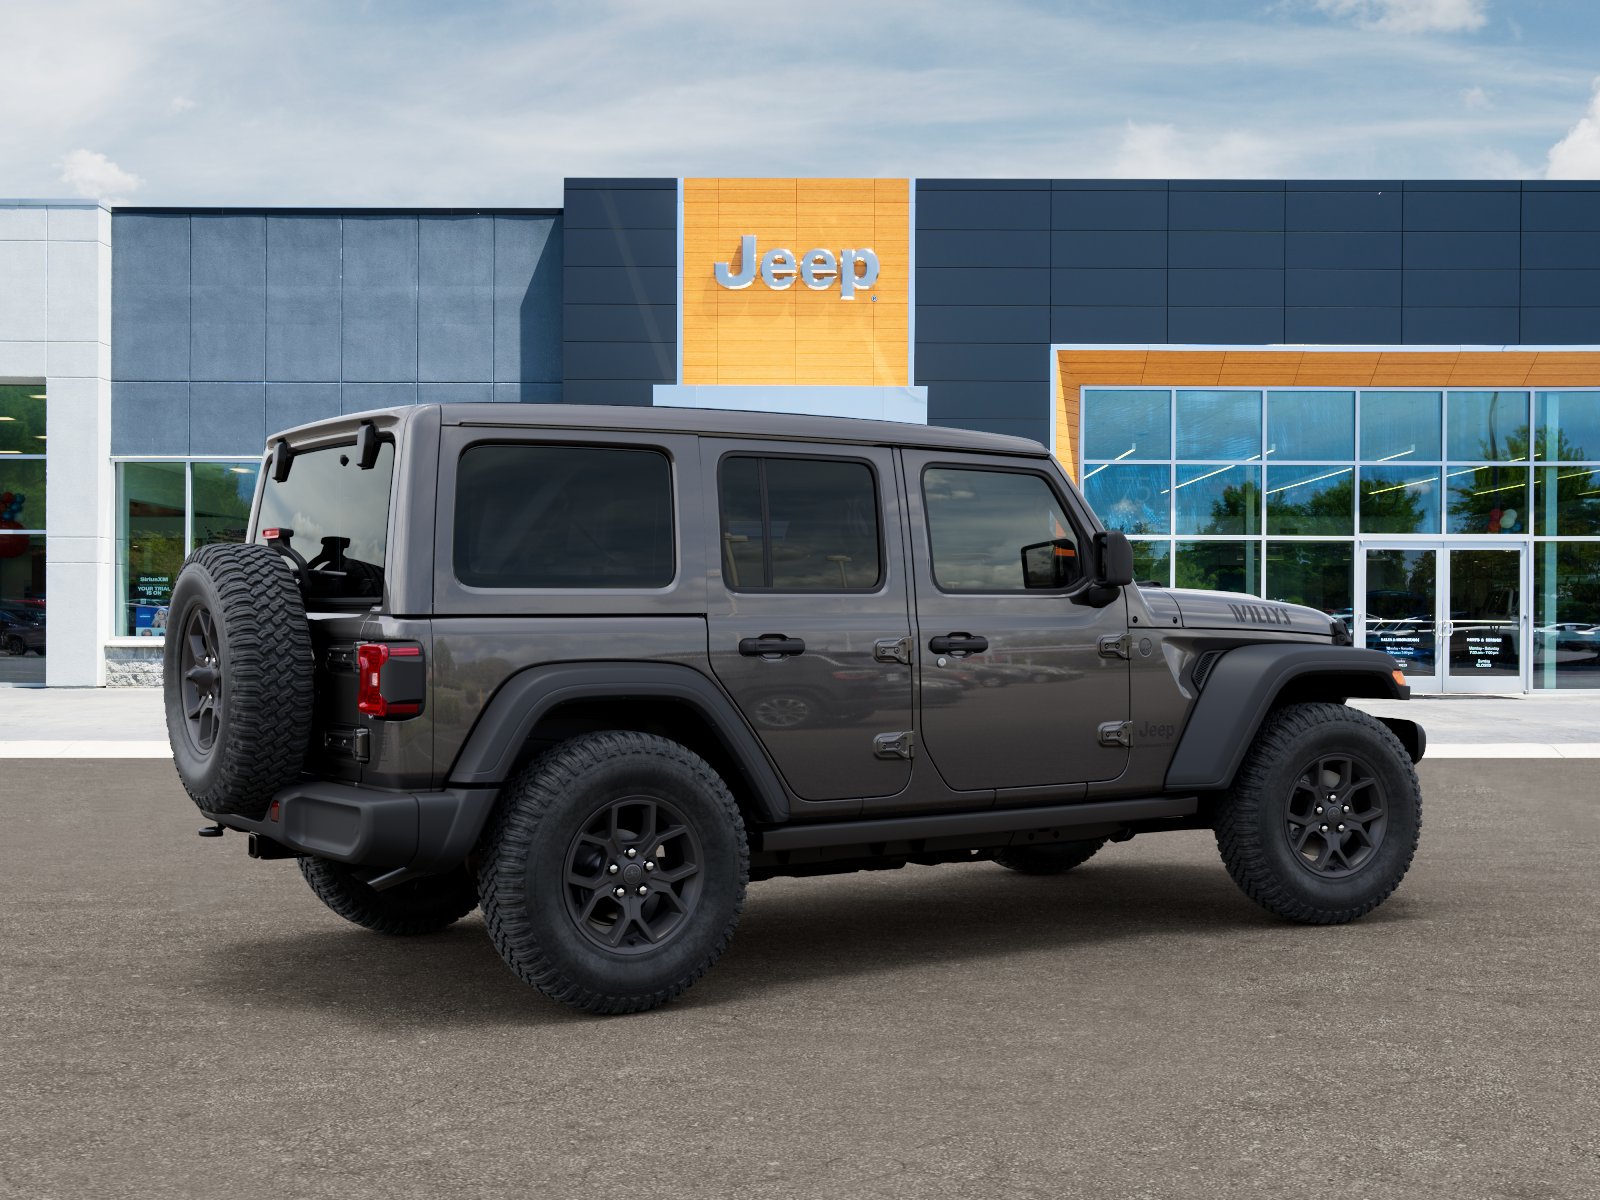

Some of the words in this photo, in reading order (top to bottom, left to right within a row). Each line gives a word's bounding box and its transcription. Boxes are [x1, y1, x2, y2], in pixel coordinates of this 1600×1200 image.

[713, 234, 880, 301] Jeep
[1226, 603, 1292, 626] WILLYS
[1138, 720, 1175, 740] Jeep
